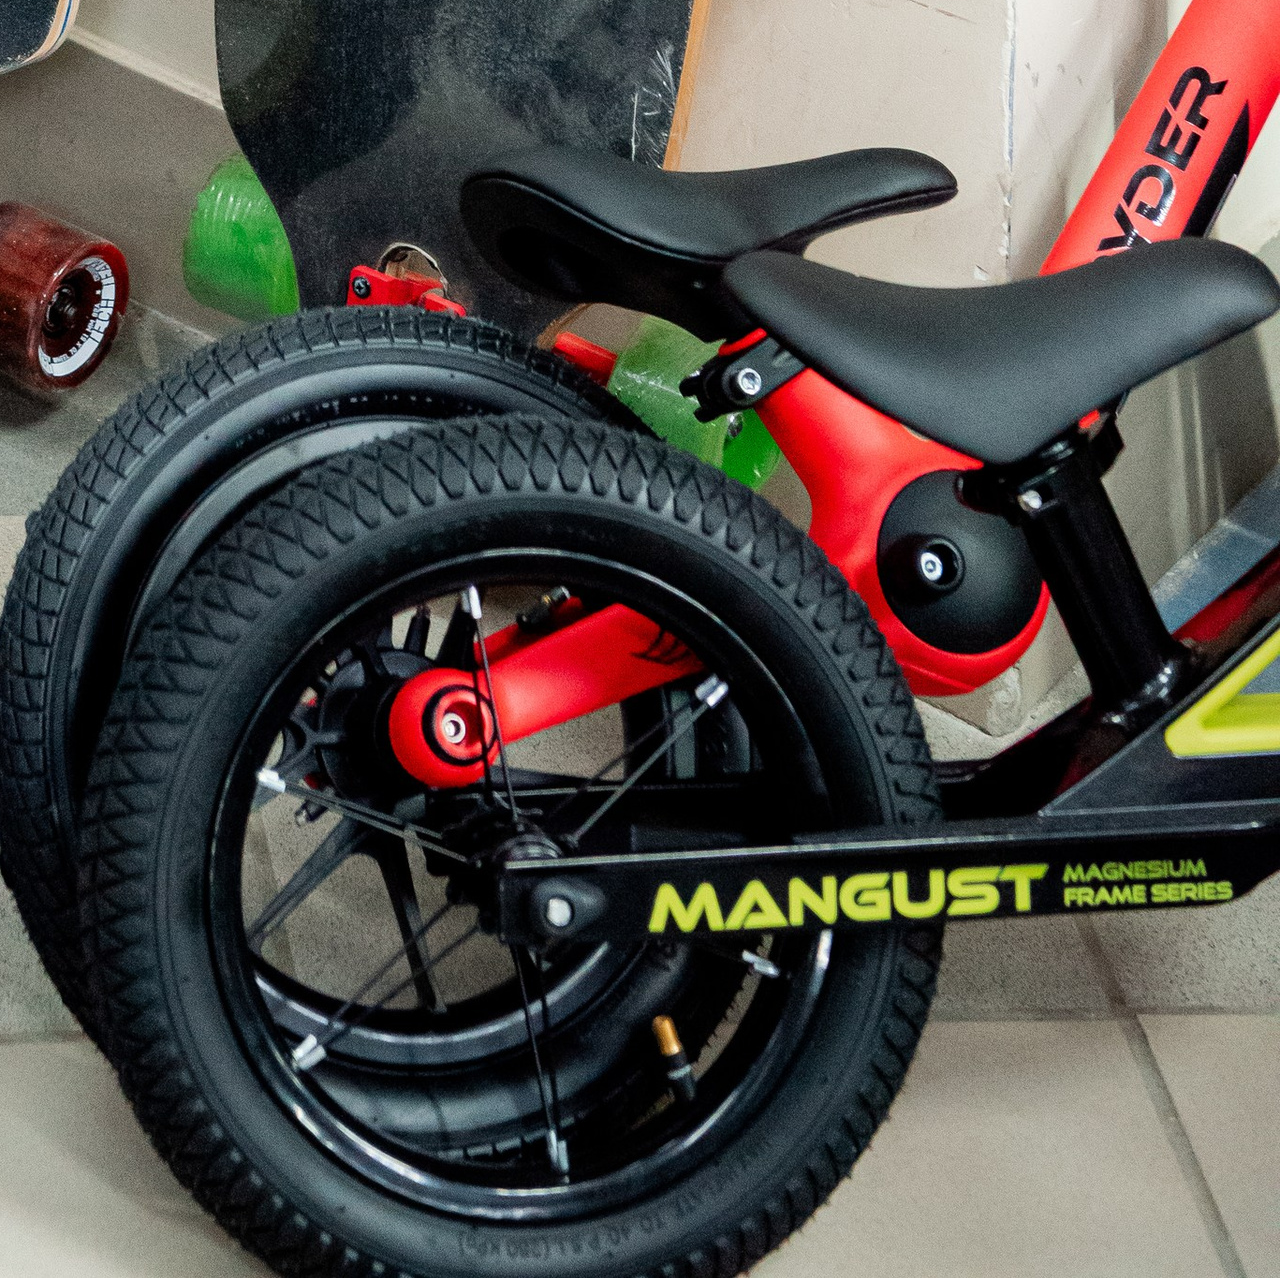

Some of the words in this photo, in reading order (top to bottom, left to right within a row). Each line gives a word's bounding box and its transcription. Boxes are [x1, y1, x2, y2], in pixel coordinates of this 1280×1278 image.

[1097, 66, 1228, 253] YDER
[1063, 858, 1207, 883] MAGNESIUM
[1063, 883, 1147, 905] FRAME
[1150, 880, 1234, 904] SERIES
[648, 863, 1049, 933] MANGUST
